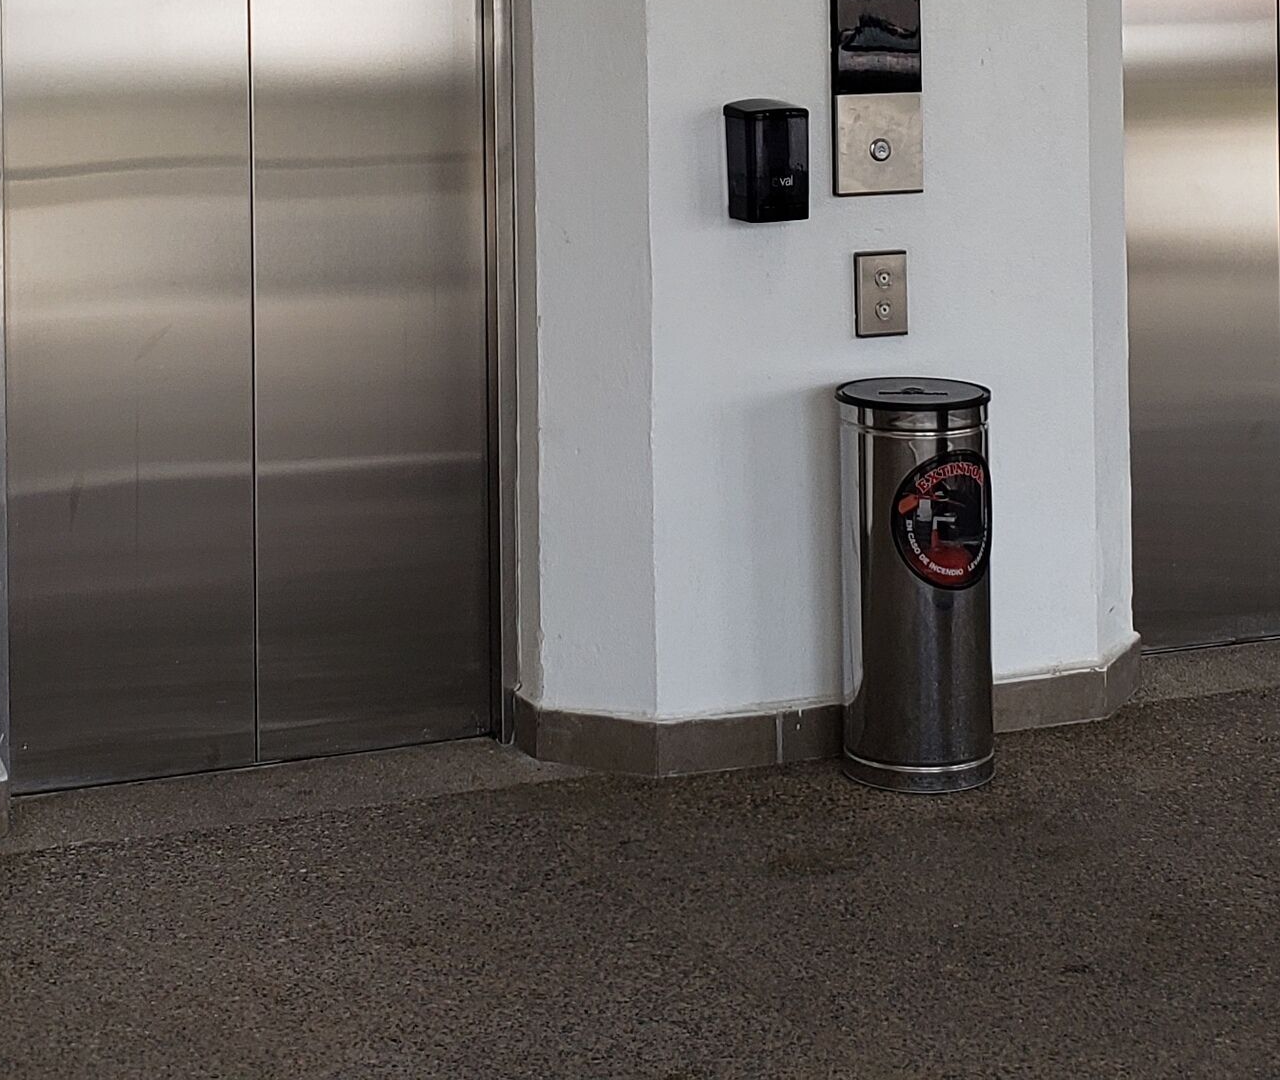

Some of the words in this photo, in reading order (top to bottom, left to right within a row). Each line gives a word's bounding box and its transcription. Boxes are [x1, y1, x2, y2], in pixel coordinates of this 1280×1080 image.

[908, 532, 921, 555] CASO
[919, 555, 931, 566] DE
[929, 562, 964, 577] INCENDIO
